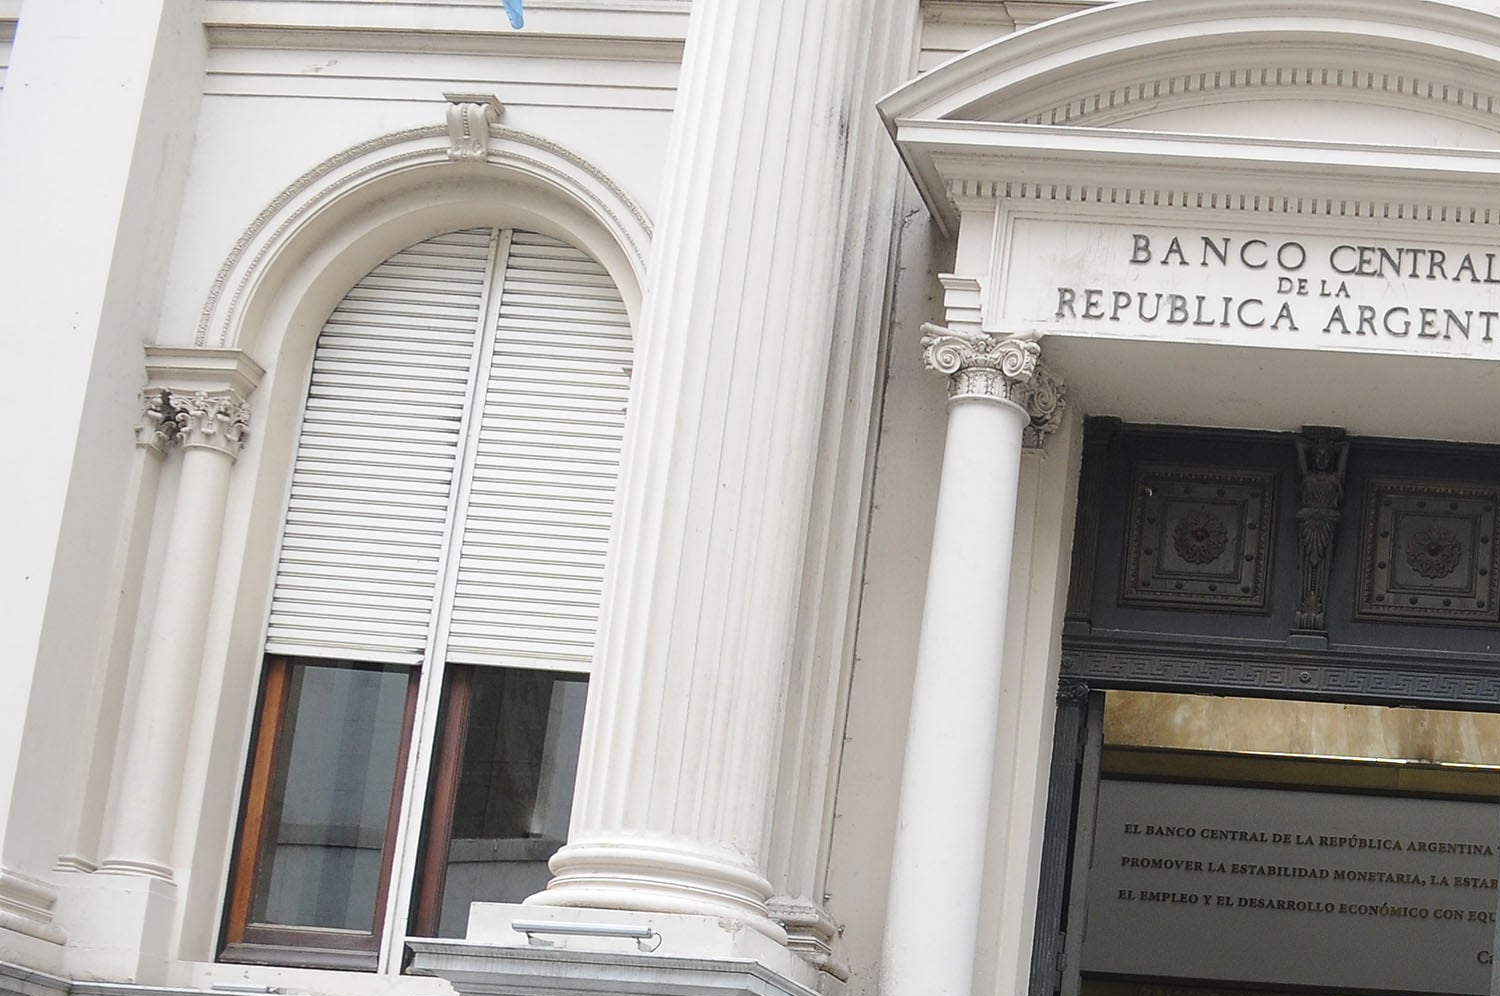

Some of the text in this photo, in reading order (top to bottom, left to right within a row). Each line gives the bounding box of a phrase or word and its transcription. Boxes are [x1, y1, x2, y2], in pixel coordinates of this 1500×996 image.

[1129, 233, 1307, 272] BANCO
[1276, 276, 1352, 299] DE LA
[1055, 286, 1299, 332] REPUBLICA
[1124, 823, 1142, 836] EL
[1145, 824, 1197, 839] BANCO
[1200, 828, 1268, 844] CENTRAL
[1272, 832, 1292, 845] DE
[1295, 834, 1315, 847] LA
[1319, 833, 1403, 852] REPÚBLICA
[1406, 840, 1494, 857] ARGENTINA
[1120, 856, 1204, 873] PROMOVER
[1207, 861, 1227, 874] LA
[1230, 863, 1330, 881] ESTABILIDAD
[1333, 869, 1427, 888] MONETARIA,
[1430, 874, 1450, 887] LA
[1118, 889, 1136, 902] EL
[1139, 890, 1199, 905] EMPLEO
[1203, 894, 1213, 907] Y
[1216, 895, 1235, 908] EL
[1237, 896, 1335, 914] DESARROLLO
[1338, 901, 1430, 920] ECONÓMICO
[1433, 908, 1465, 921] CON
